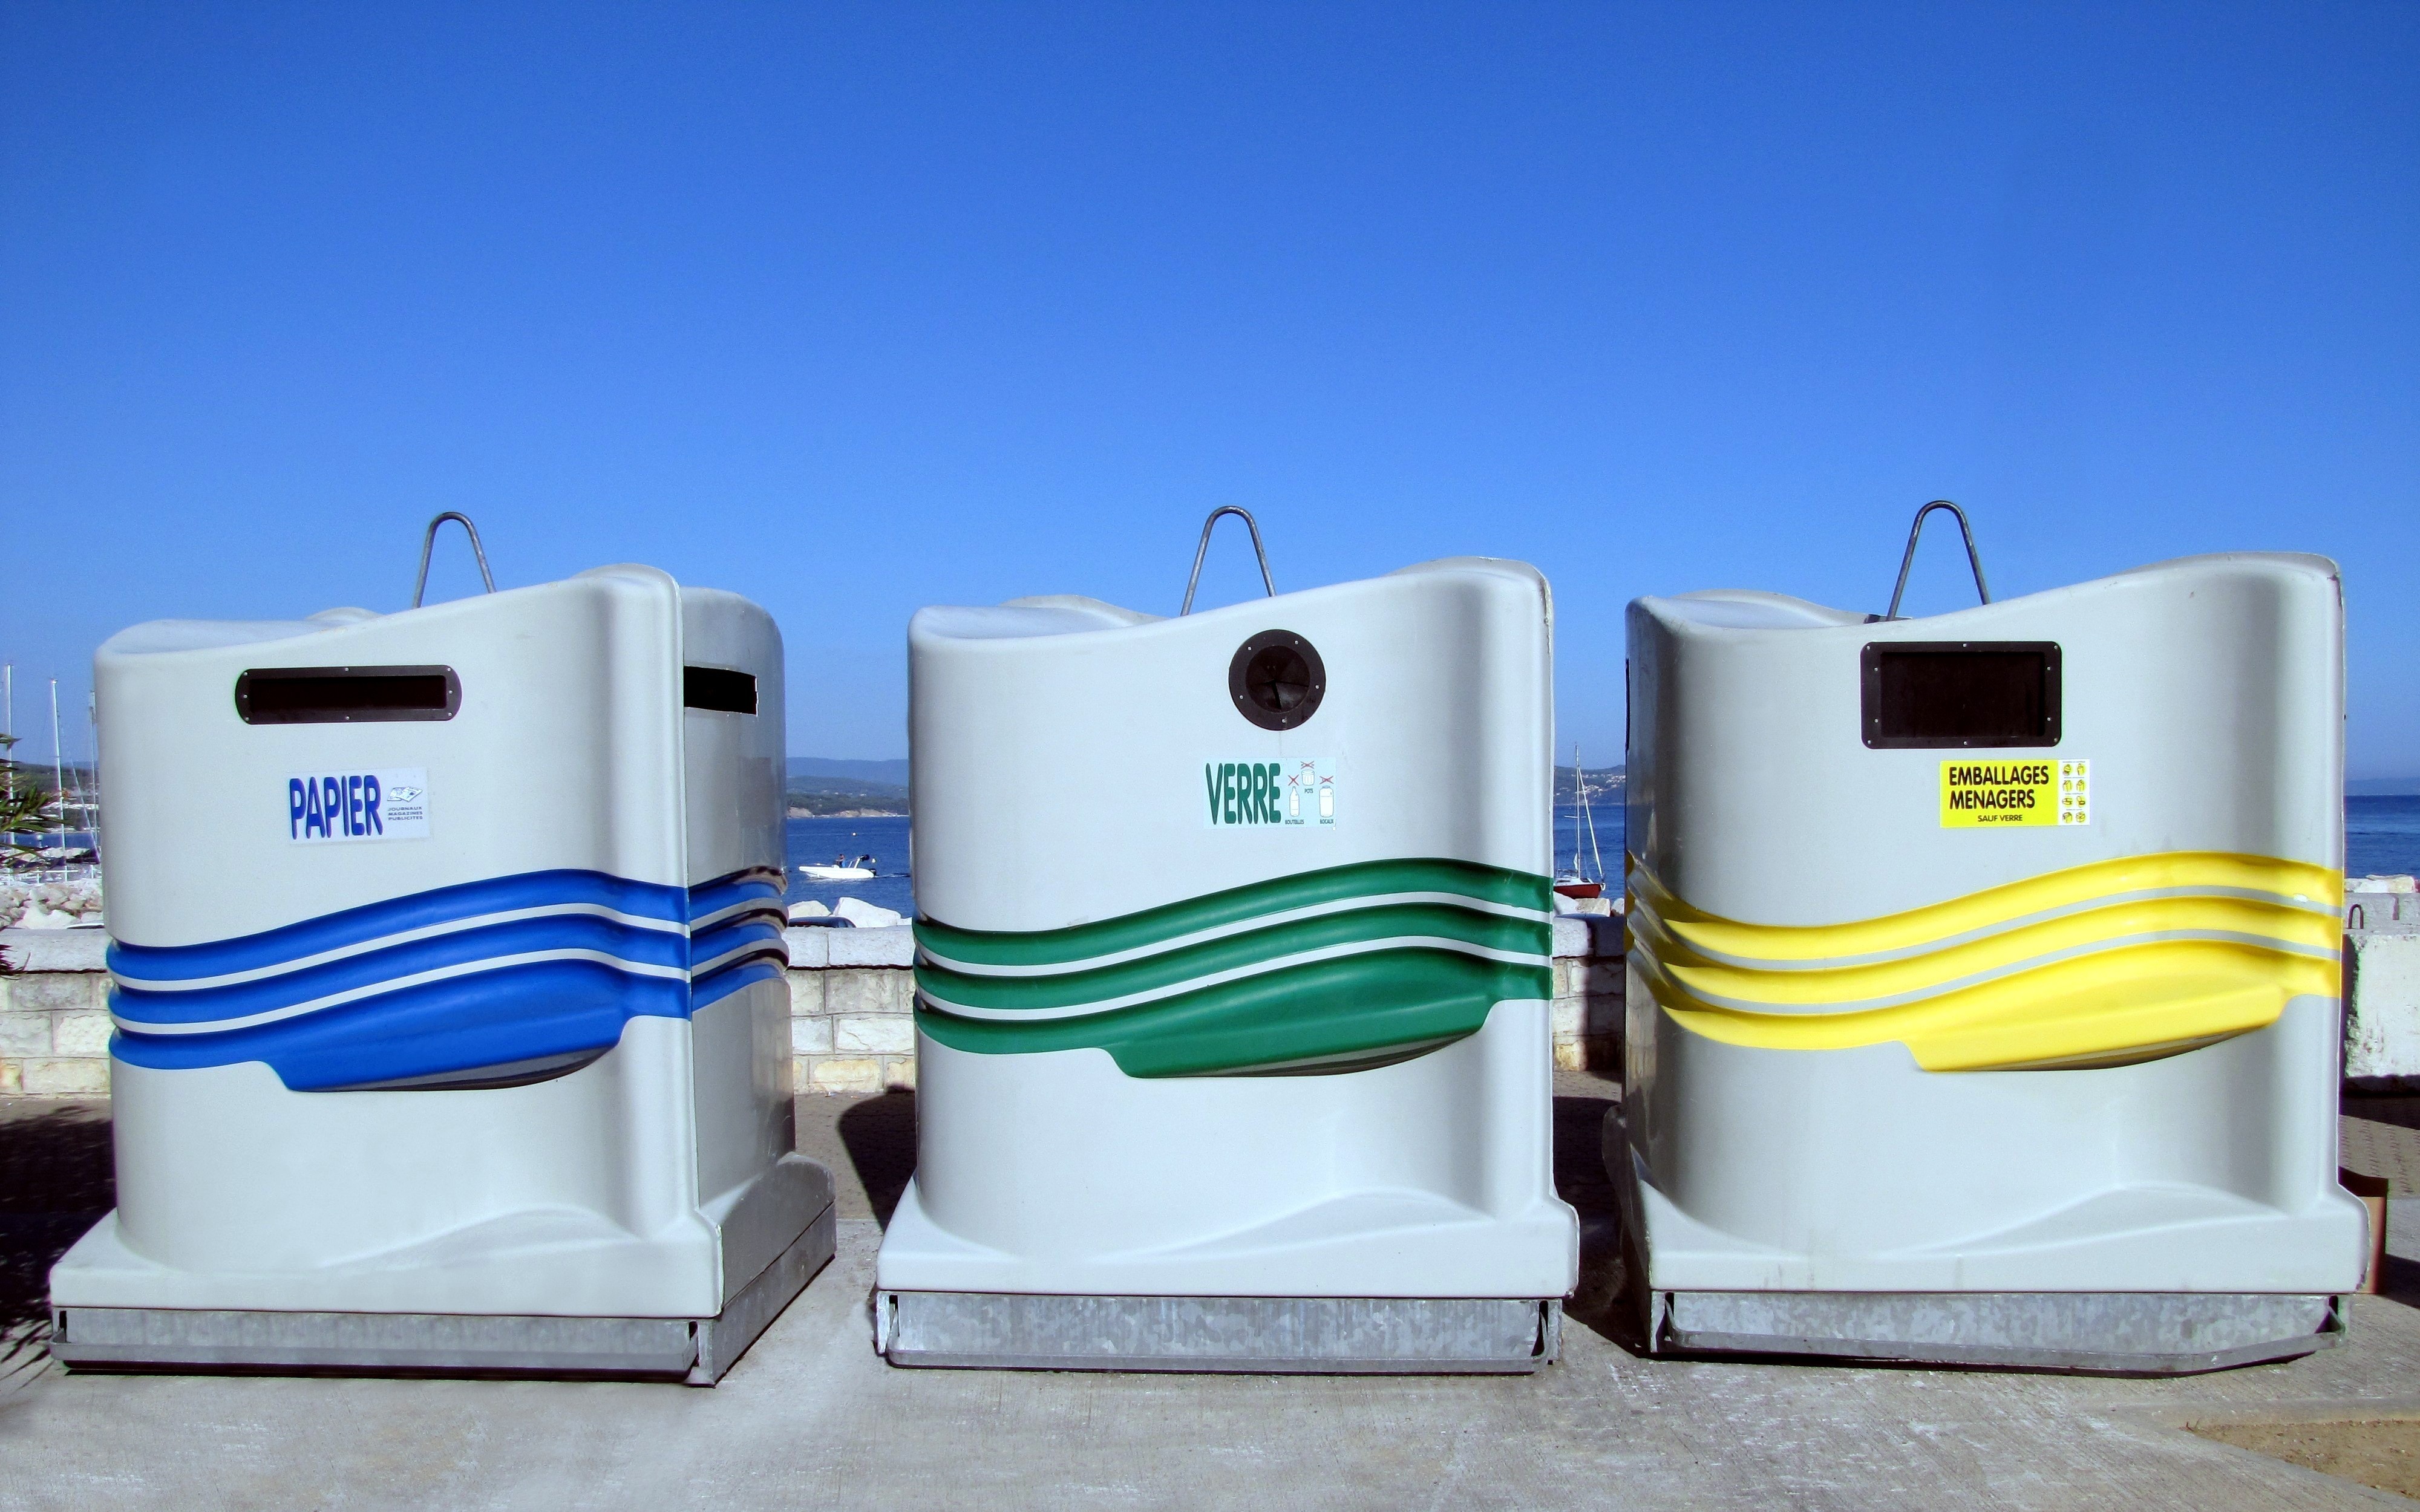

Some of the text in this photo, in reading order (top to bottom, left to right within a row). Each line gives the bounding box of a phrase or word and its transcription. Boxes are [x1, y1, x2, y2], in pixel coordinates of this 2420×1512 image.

[1205, 763, 1281, 825] VERRE
[1949, 766, 2049, 786] EMBALLAGES
[289, 775, 384, 840] PAPIER
[1949, 789, 2035, 810] MENAGERS
